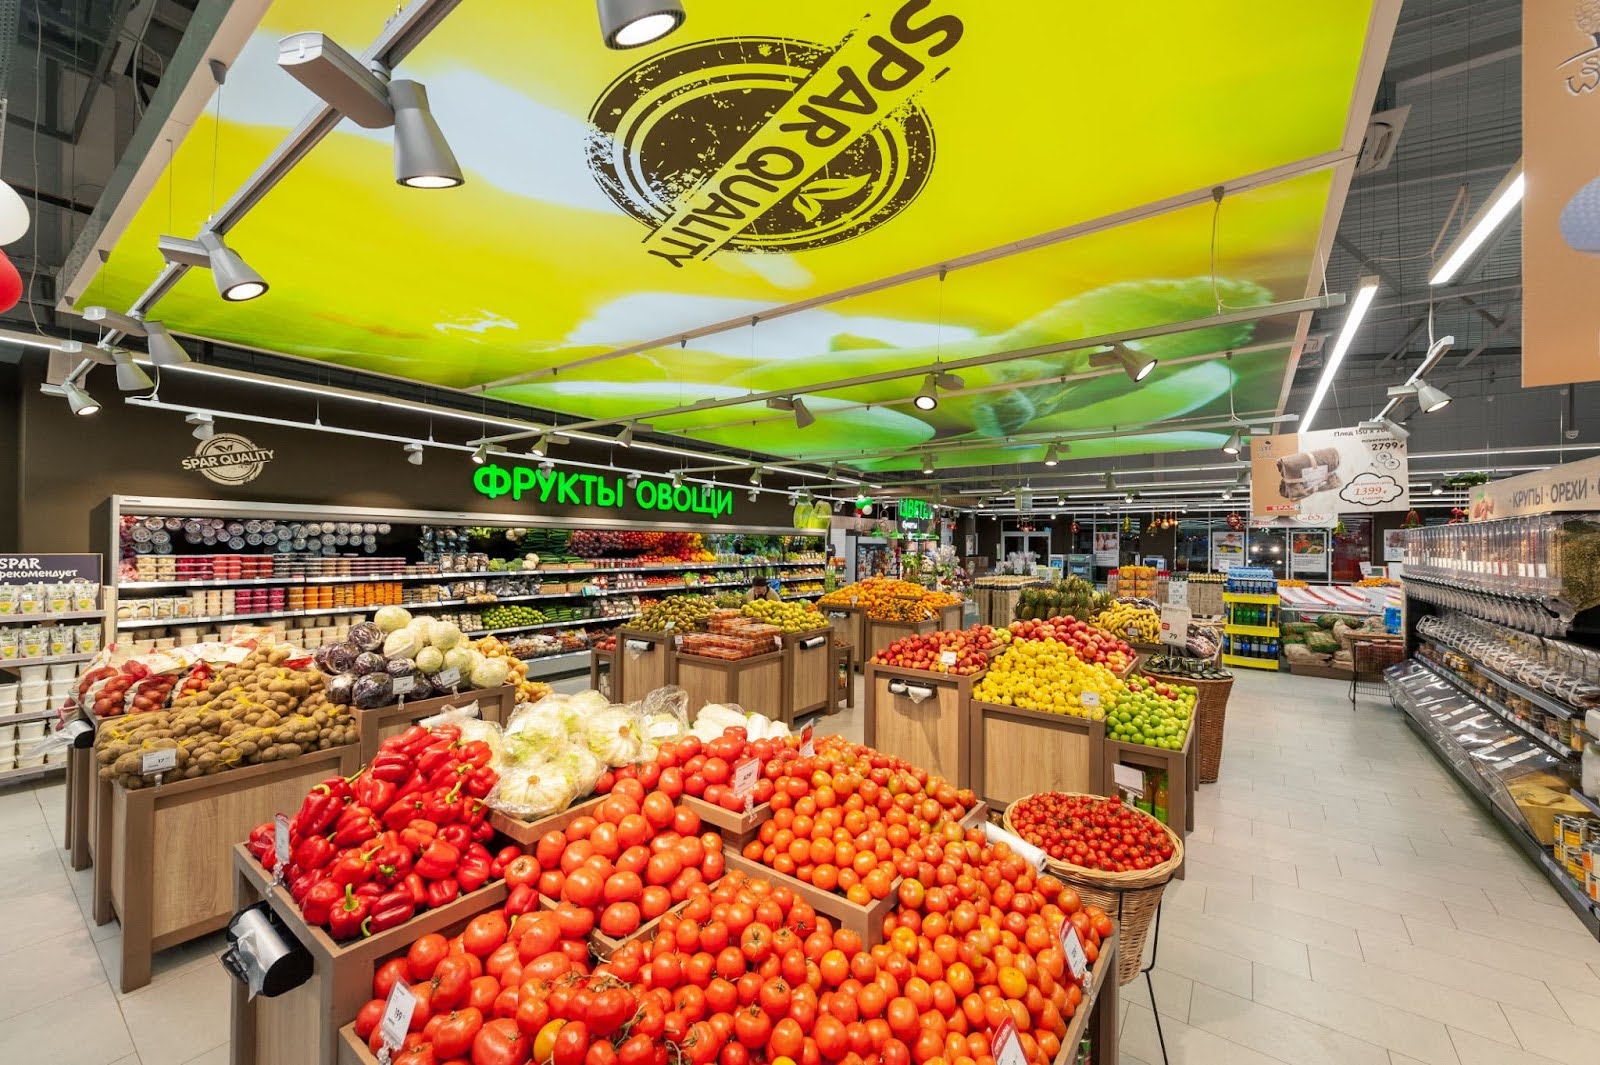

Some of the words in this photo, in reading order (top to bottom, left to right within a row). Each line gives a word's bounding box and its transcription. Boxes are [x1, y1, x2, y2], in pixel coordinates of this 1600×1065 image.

[779, 0, 964, 148] SPAR
[647, 146, 805, 268] QUALITY
[1371, 441, 1398, 451] 2799
[181, 456, 219, 470] SPAR
[219, 449, 274, 465] QUALITY
[473, 463, 625, 508] ФРУКТЫ
[635, 480, 734, 519] ОВОЩИ
[1355, 487, 1382, 496] 1399
[1512, 486, 1544, 508] КРУПЫ
[1550, 477, 1588, 504] ОРЕХИ
[0, 557, 42, 570] SPAR
[0, 569, 79, 581] рекомендует
[1169, 632, 1178, 640] 79
